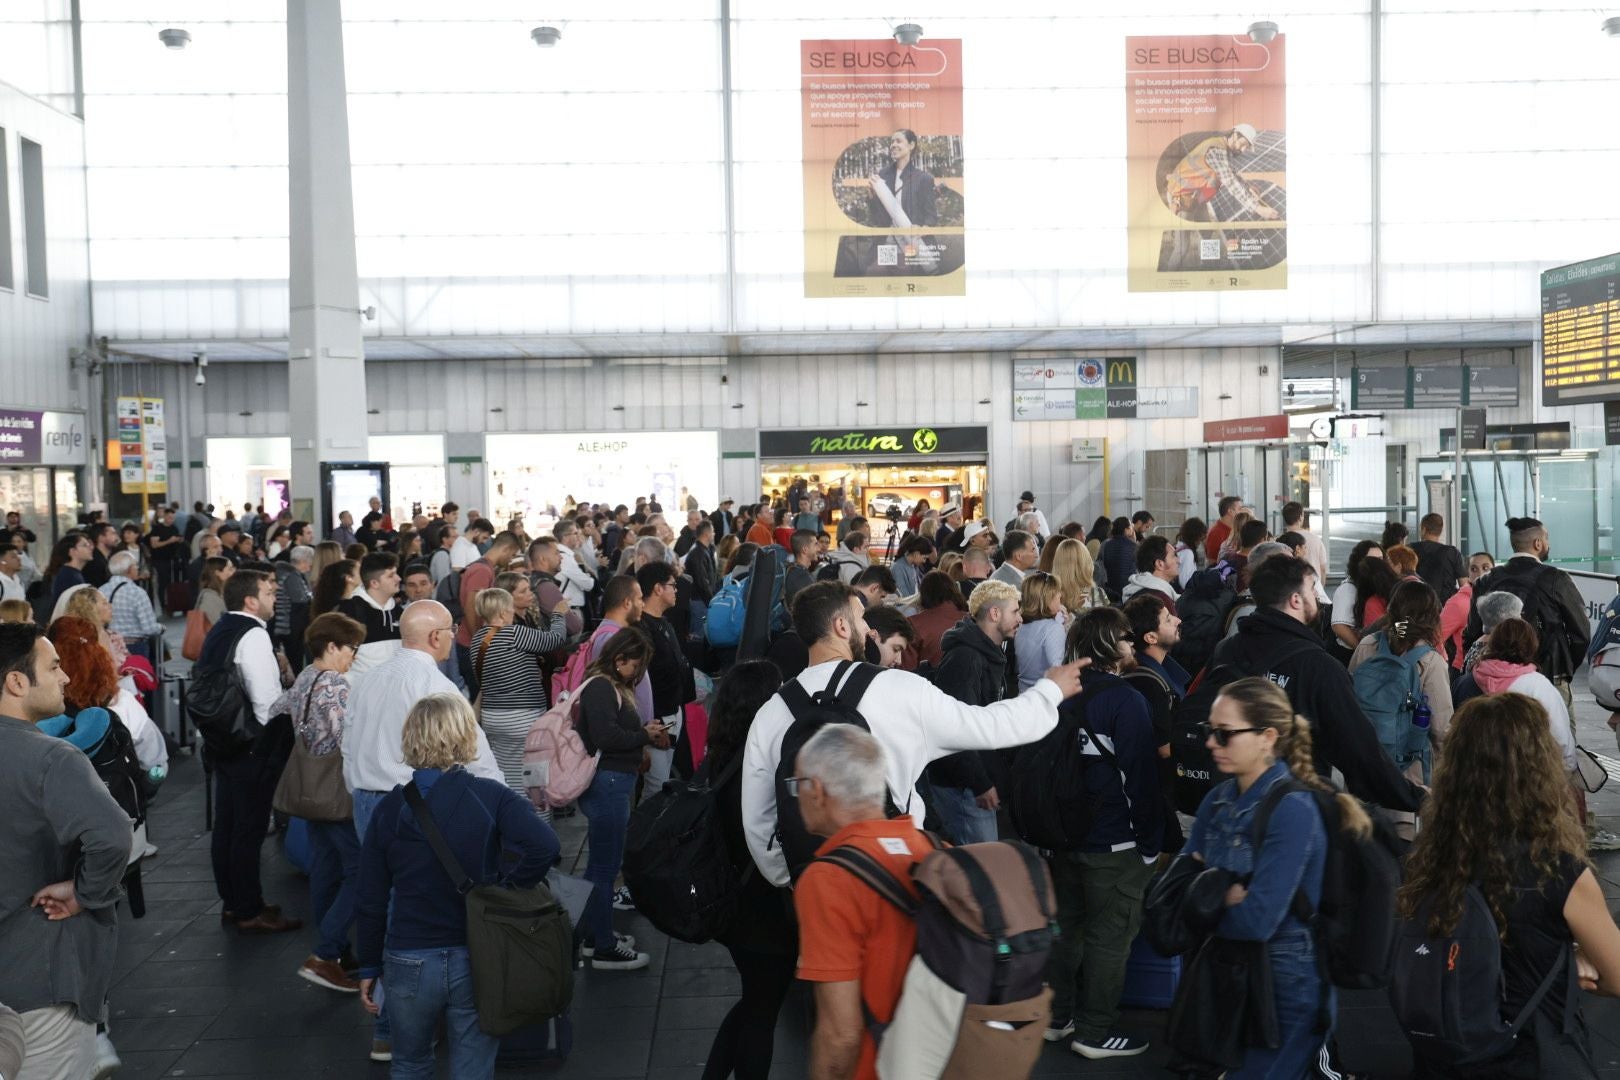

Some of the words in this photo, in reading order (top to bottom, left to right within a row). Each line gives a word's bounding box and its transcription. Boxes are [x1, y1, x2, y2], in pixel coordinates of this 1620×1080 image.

[809, 51, 836, 68] SE
[842, 51, 916, 68] BUSCA
[1134, 48, 1161, 64] SE
[1167, 47, 1239, 64] BUSCA
[1171, 79, 1203, 87] persona
[1154, 87, 1197, 95] innovación
[1197, 88, 1212, 96] que
[810, 101, 858, 109] innovadores
[893, 101, 925, 109] impacto
[1135, 97, 1163, 105] escalar
[1175, 97, 1207, 105] negocio
[1194, 105, 1217, 114] global
[857, 111, 881, 119] digital
[1360, 374, 1366, 383] 9
[1416, 372, 1422, 382] 8
[1471, 371, 1478, 381] 7
[1107, 400, 1137, 408] ALE-HOP
[46, 423, 82, 455] renfe
[810, 432, 903, 453] natura
[578, 441, 628, 453] ALE-HOP
